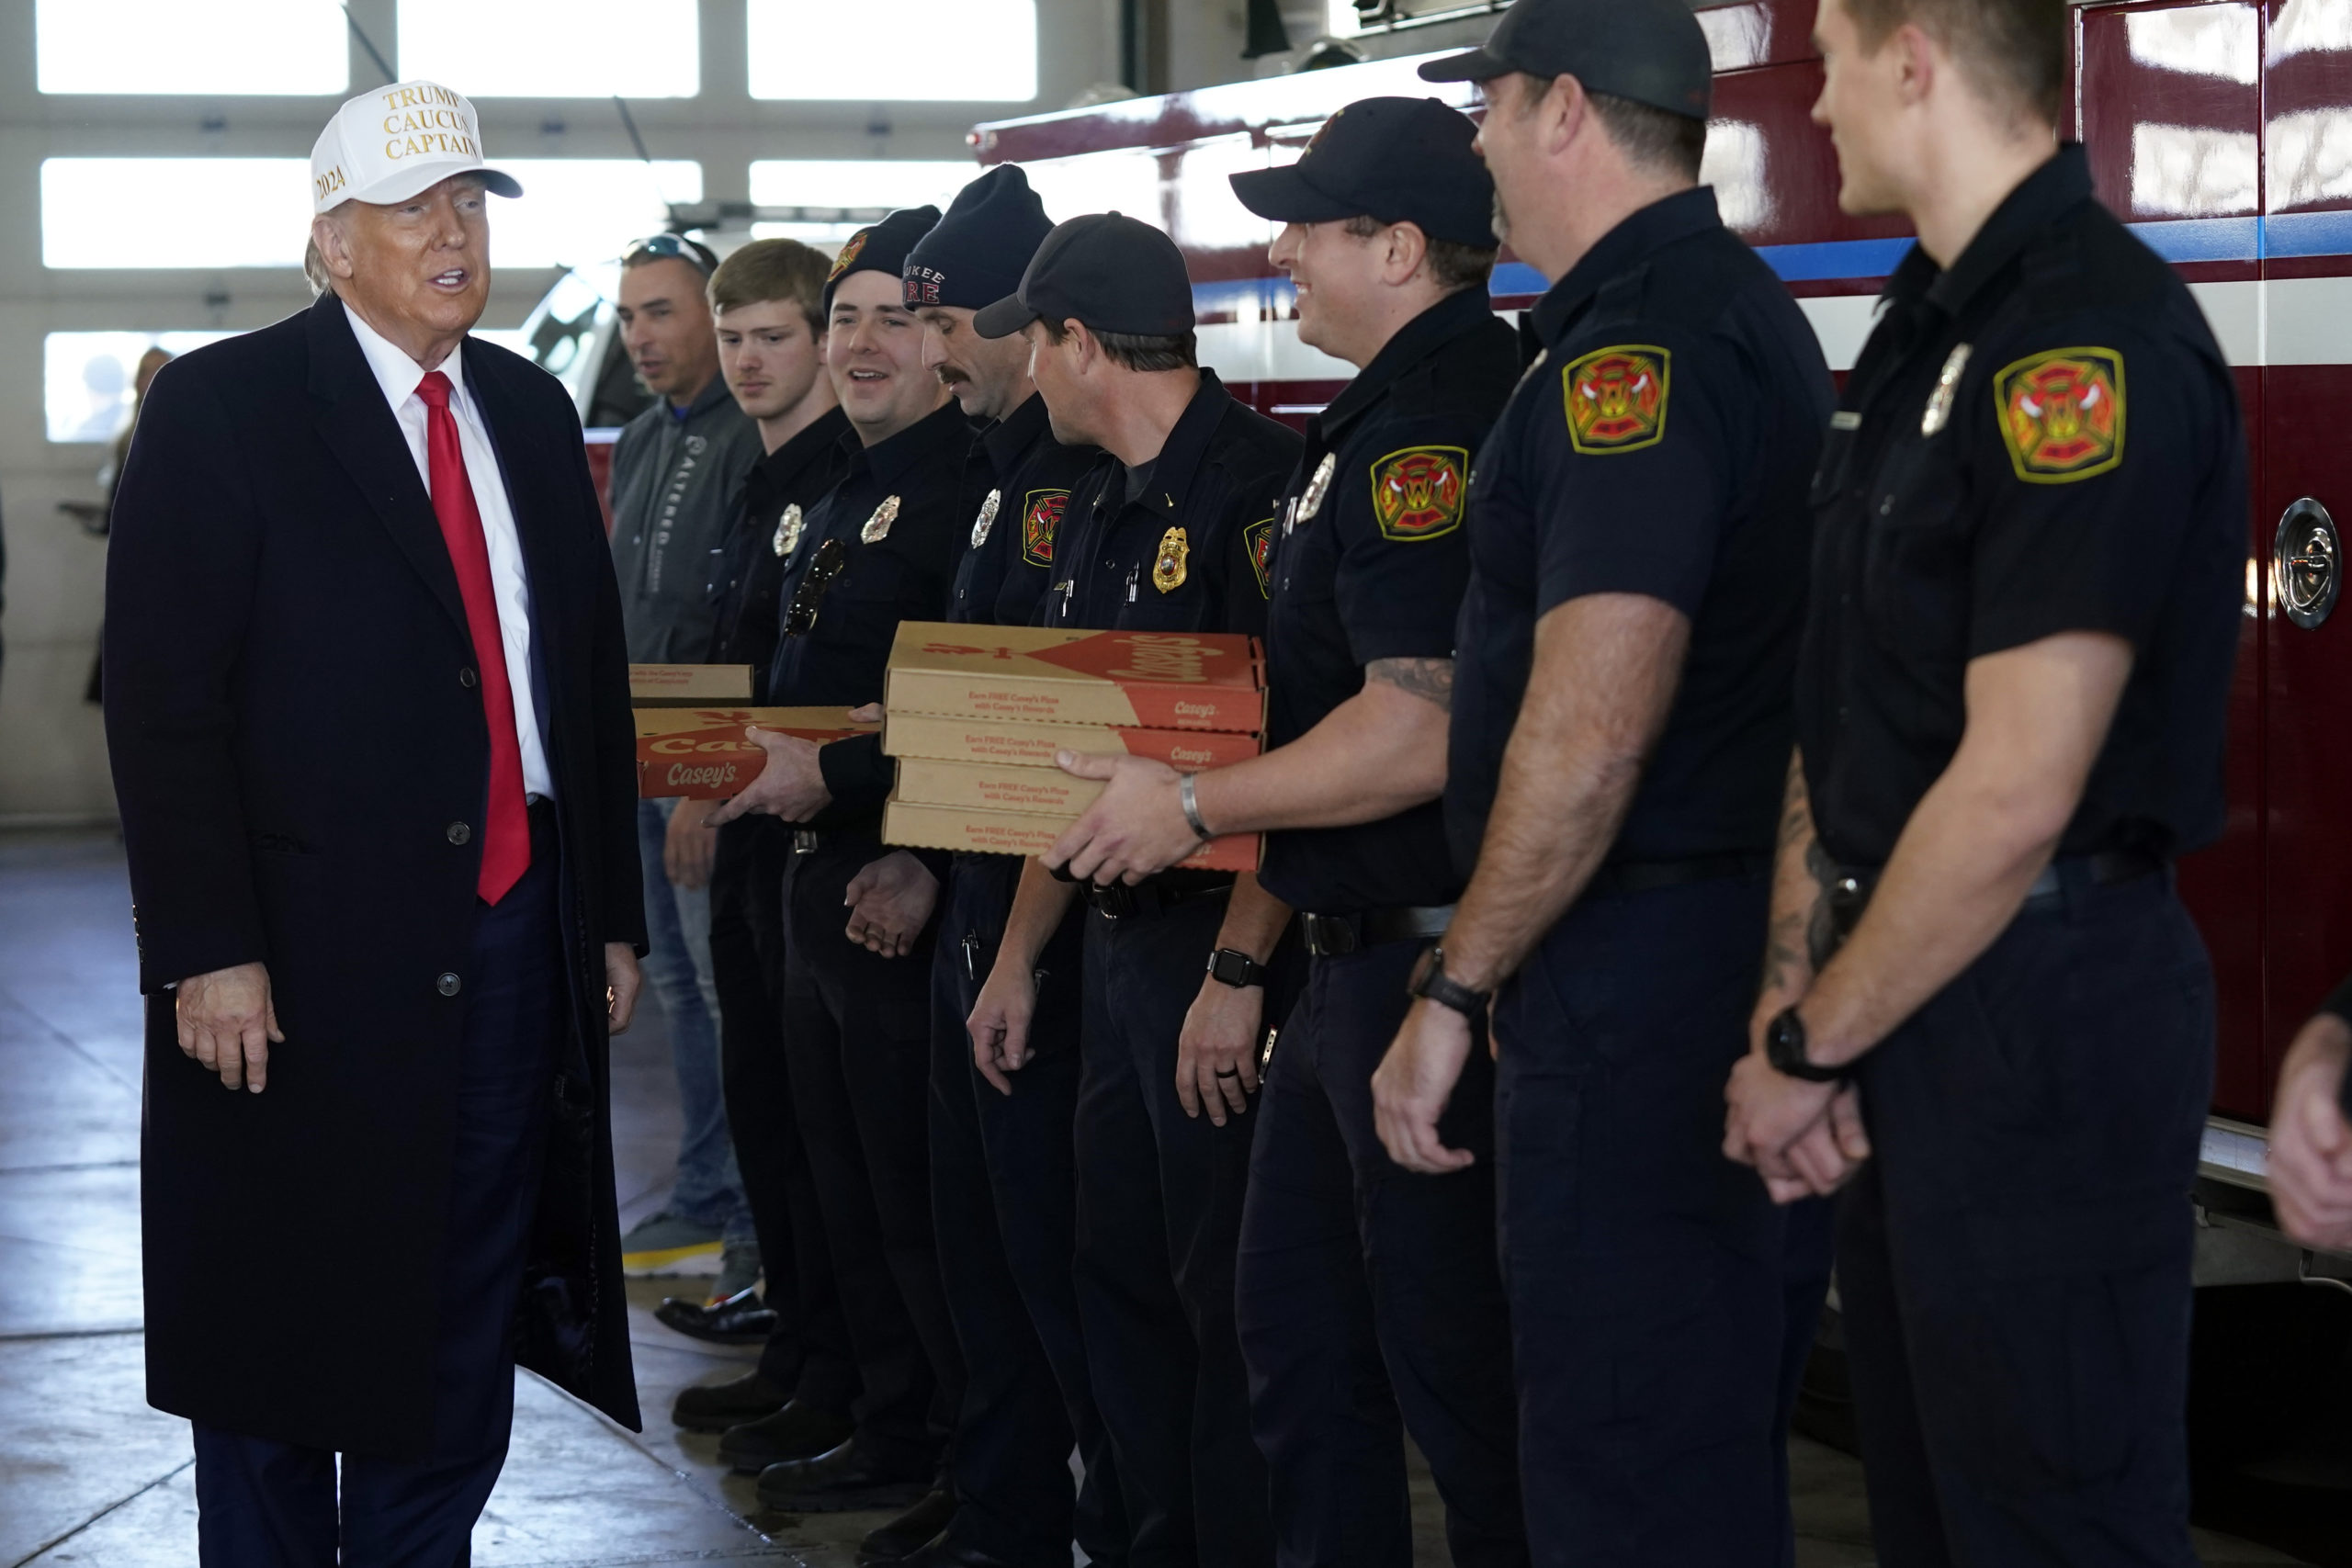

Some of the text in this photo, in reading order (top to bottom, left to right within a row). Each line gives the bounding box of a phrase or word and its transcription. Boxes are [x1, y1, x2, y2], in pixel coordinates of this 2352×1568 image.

[382, 85, 459, 110] TRUMP
[383, 109, 470, 134] CAUCUS
[385, 133, 478, 160] CAPTAIN
[316, 164, 345, 200] 2024
[905, 265, 945, 284] UKEE
[905, 281, 940, 304] RE
[989, 692, 1009, 701] FREE
[1011, 694, 1039, 704] Casey's
[1174, 701, 1216, 718] Casey's
[984, 736, 1005, 745] FREE
[1007, 738, 1035, 748] Casey's
[1170, 746, 1213, 764] Casey's
[667, 762, 737, 789] Casey's
[998, 782, 1018, 791] FREE
[1021, 784, 1048, 795] Casey's
[985, 826, 1006, 836] FREE
[1007, 828, 1035, 839] Casey's
